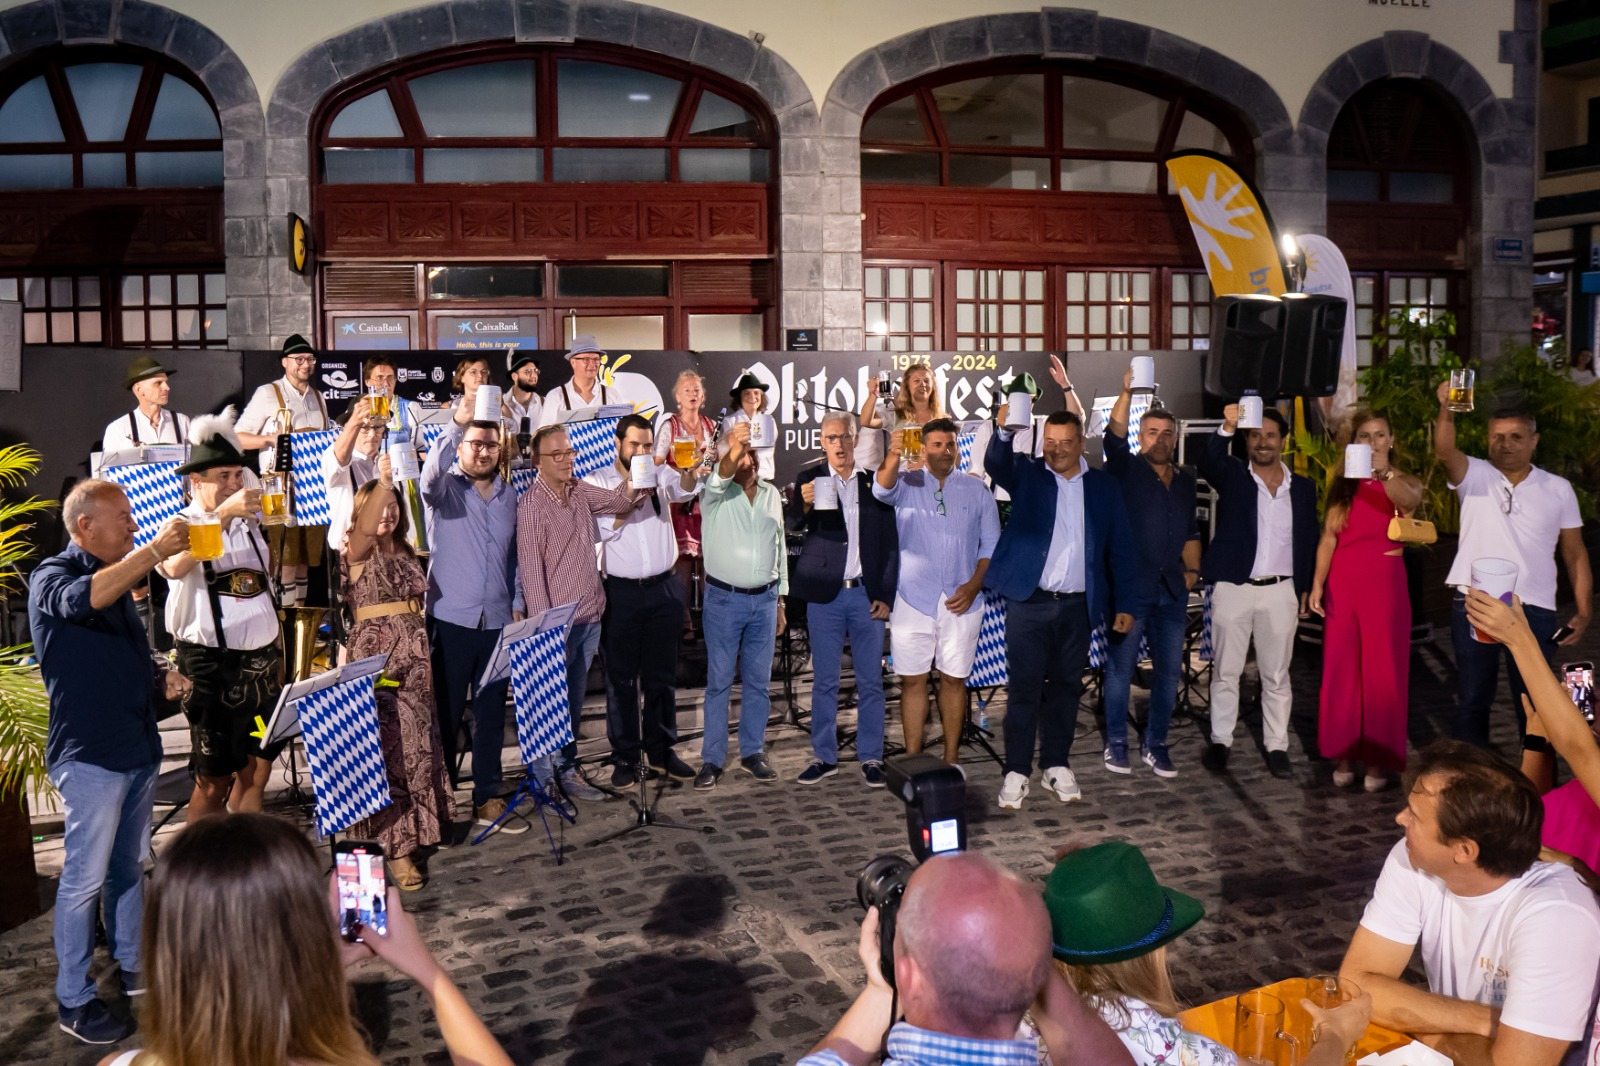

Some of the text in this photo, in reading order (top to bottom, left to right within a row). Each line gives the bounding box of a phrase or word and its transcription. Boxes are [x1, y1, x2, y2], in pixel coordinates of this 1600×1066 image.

[358, 322, 403, 332] CaixaBank
[475, 321, 519, 331] CaixaBank
[456, 341, 477, 349] Hello,
[891, 354, 997, 370] 1973 2024
[322, 388, 340, 400] cit
[785, 428, 822, 451] PUE
